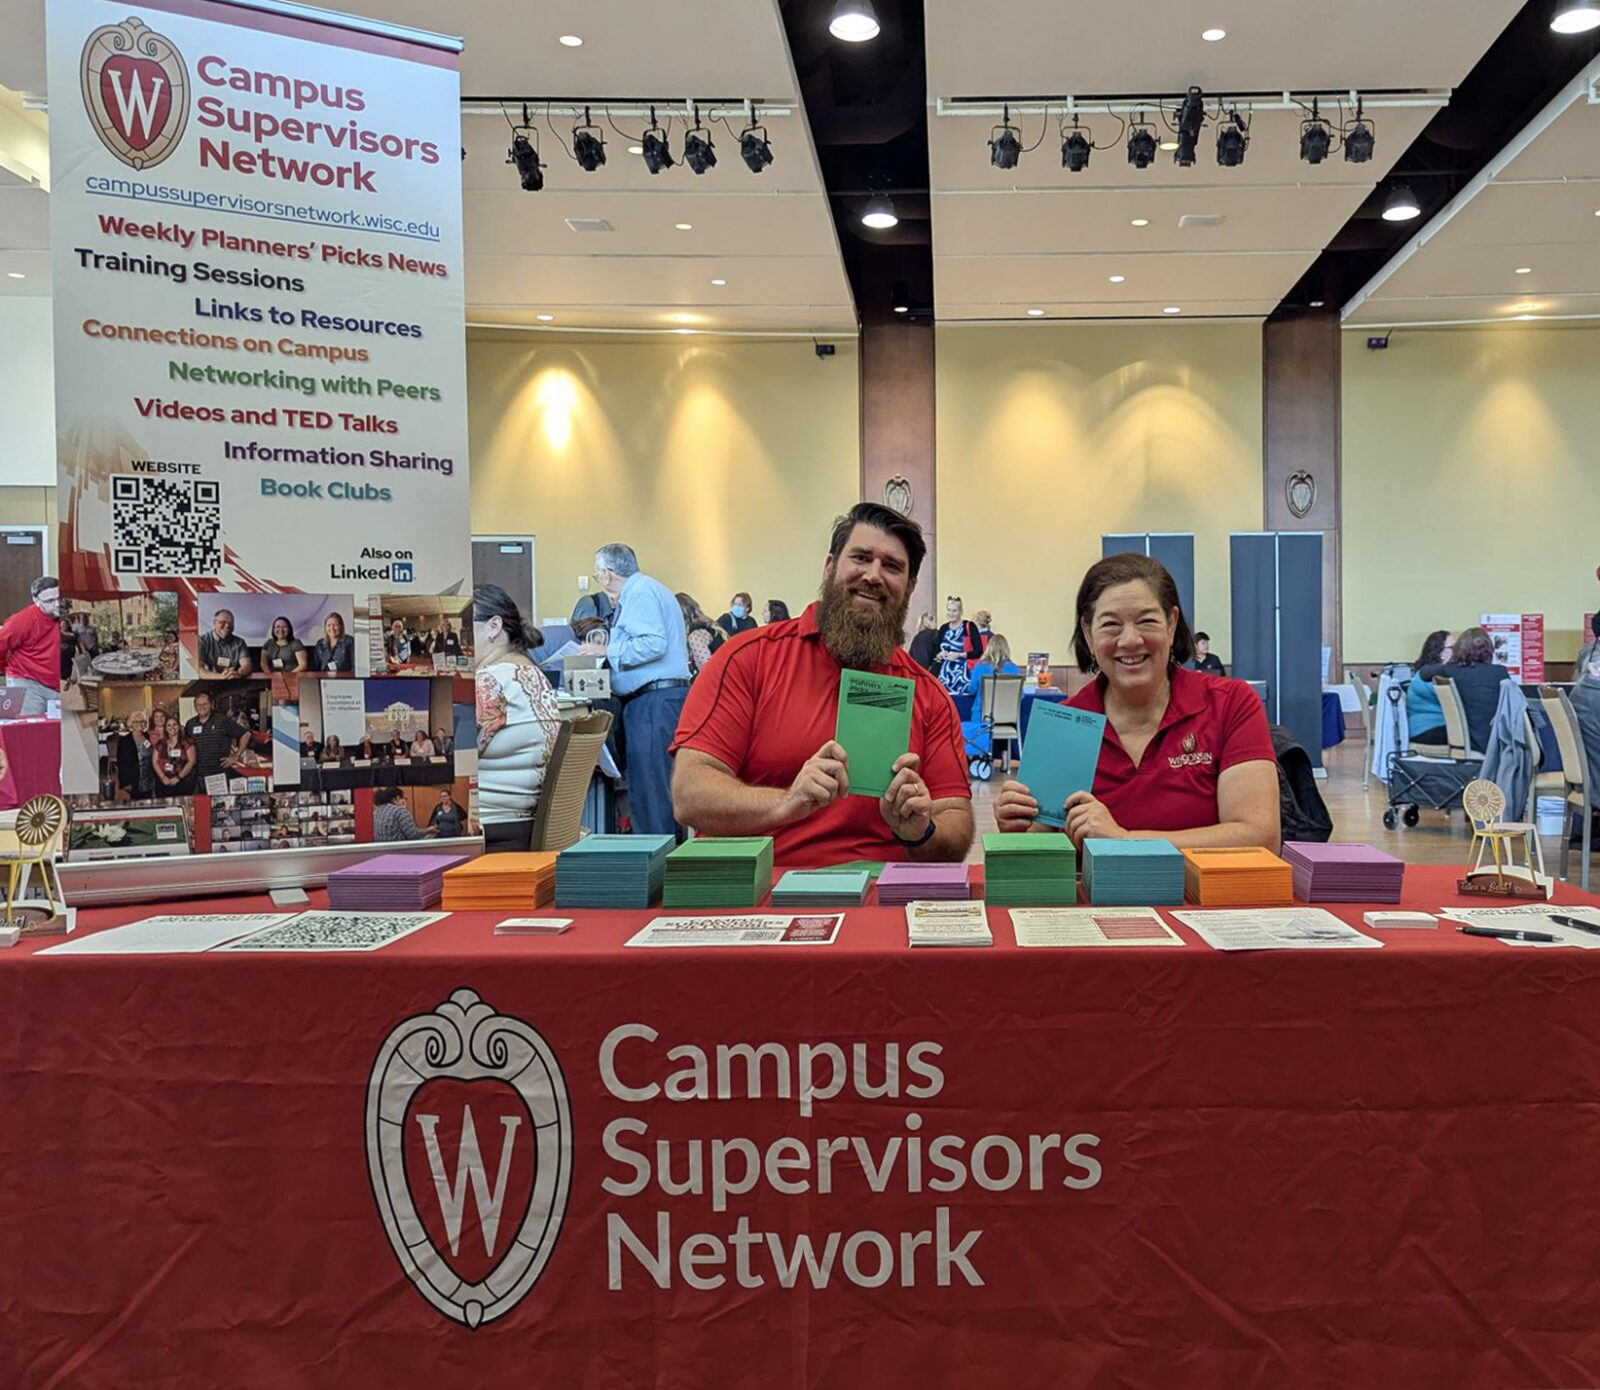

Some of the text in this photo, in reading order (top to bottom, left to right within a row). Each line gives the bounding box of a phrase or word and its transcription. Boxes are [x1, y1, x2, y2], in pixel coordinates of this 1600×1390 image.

[108, 68, 164, 142] W
[197, 55, 366, 112] Campus
[197, 96, 440, 165] Supervisors
[199, 138, 377, 193] Network
[86, 175, 441, 241] campussupervisorsnetwork.wisc.edu
[74, 247, 305, 292] Training Sessions
[98, 213, 195, 249] Weekly
[321, 243, 383, 269] Picks
[388, 253, 448, 278] News
[82, 319, 369, 364] Connections on Campus
[195, 297, 422, 338] Links to Resources
[169, 361, 442, 402] Networking with Peers
[134, 398, 398, 434] Videos and TED Talks
[131, 460, 201, 475] WEBSITE
[224, 441, 453, 476] Information Sharing
[260, 478, 392, 501] Book Clubs
[360, 547, 412, 560] Also on
[599, 1022, 945, 1117] Campus
[415, 1104, 521, 1258] W
[600, 1112, 1103, 1212] Supervisors
[607, 1206, 985, 1291] Network
